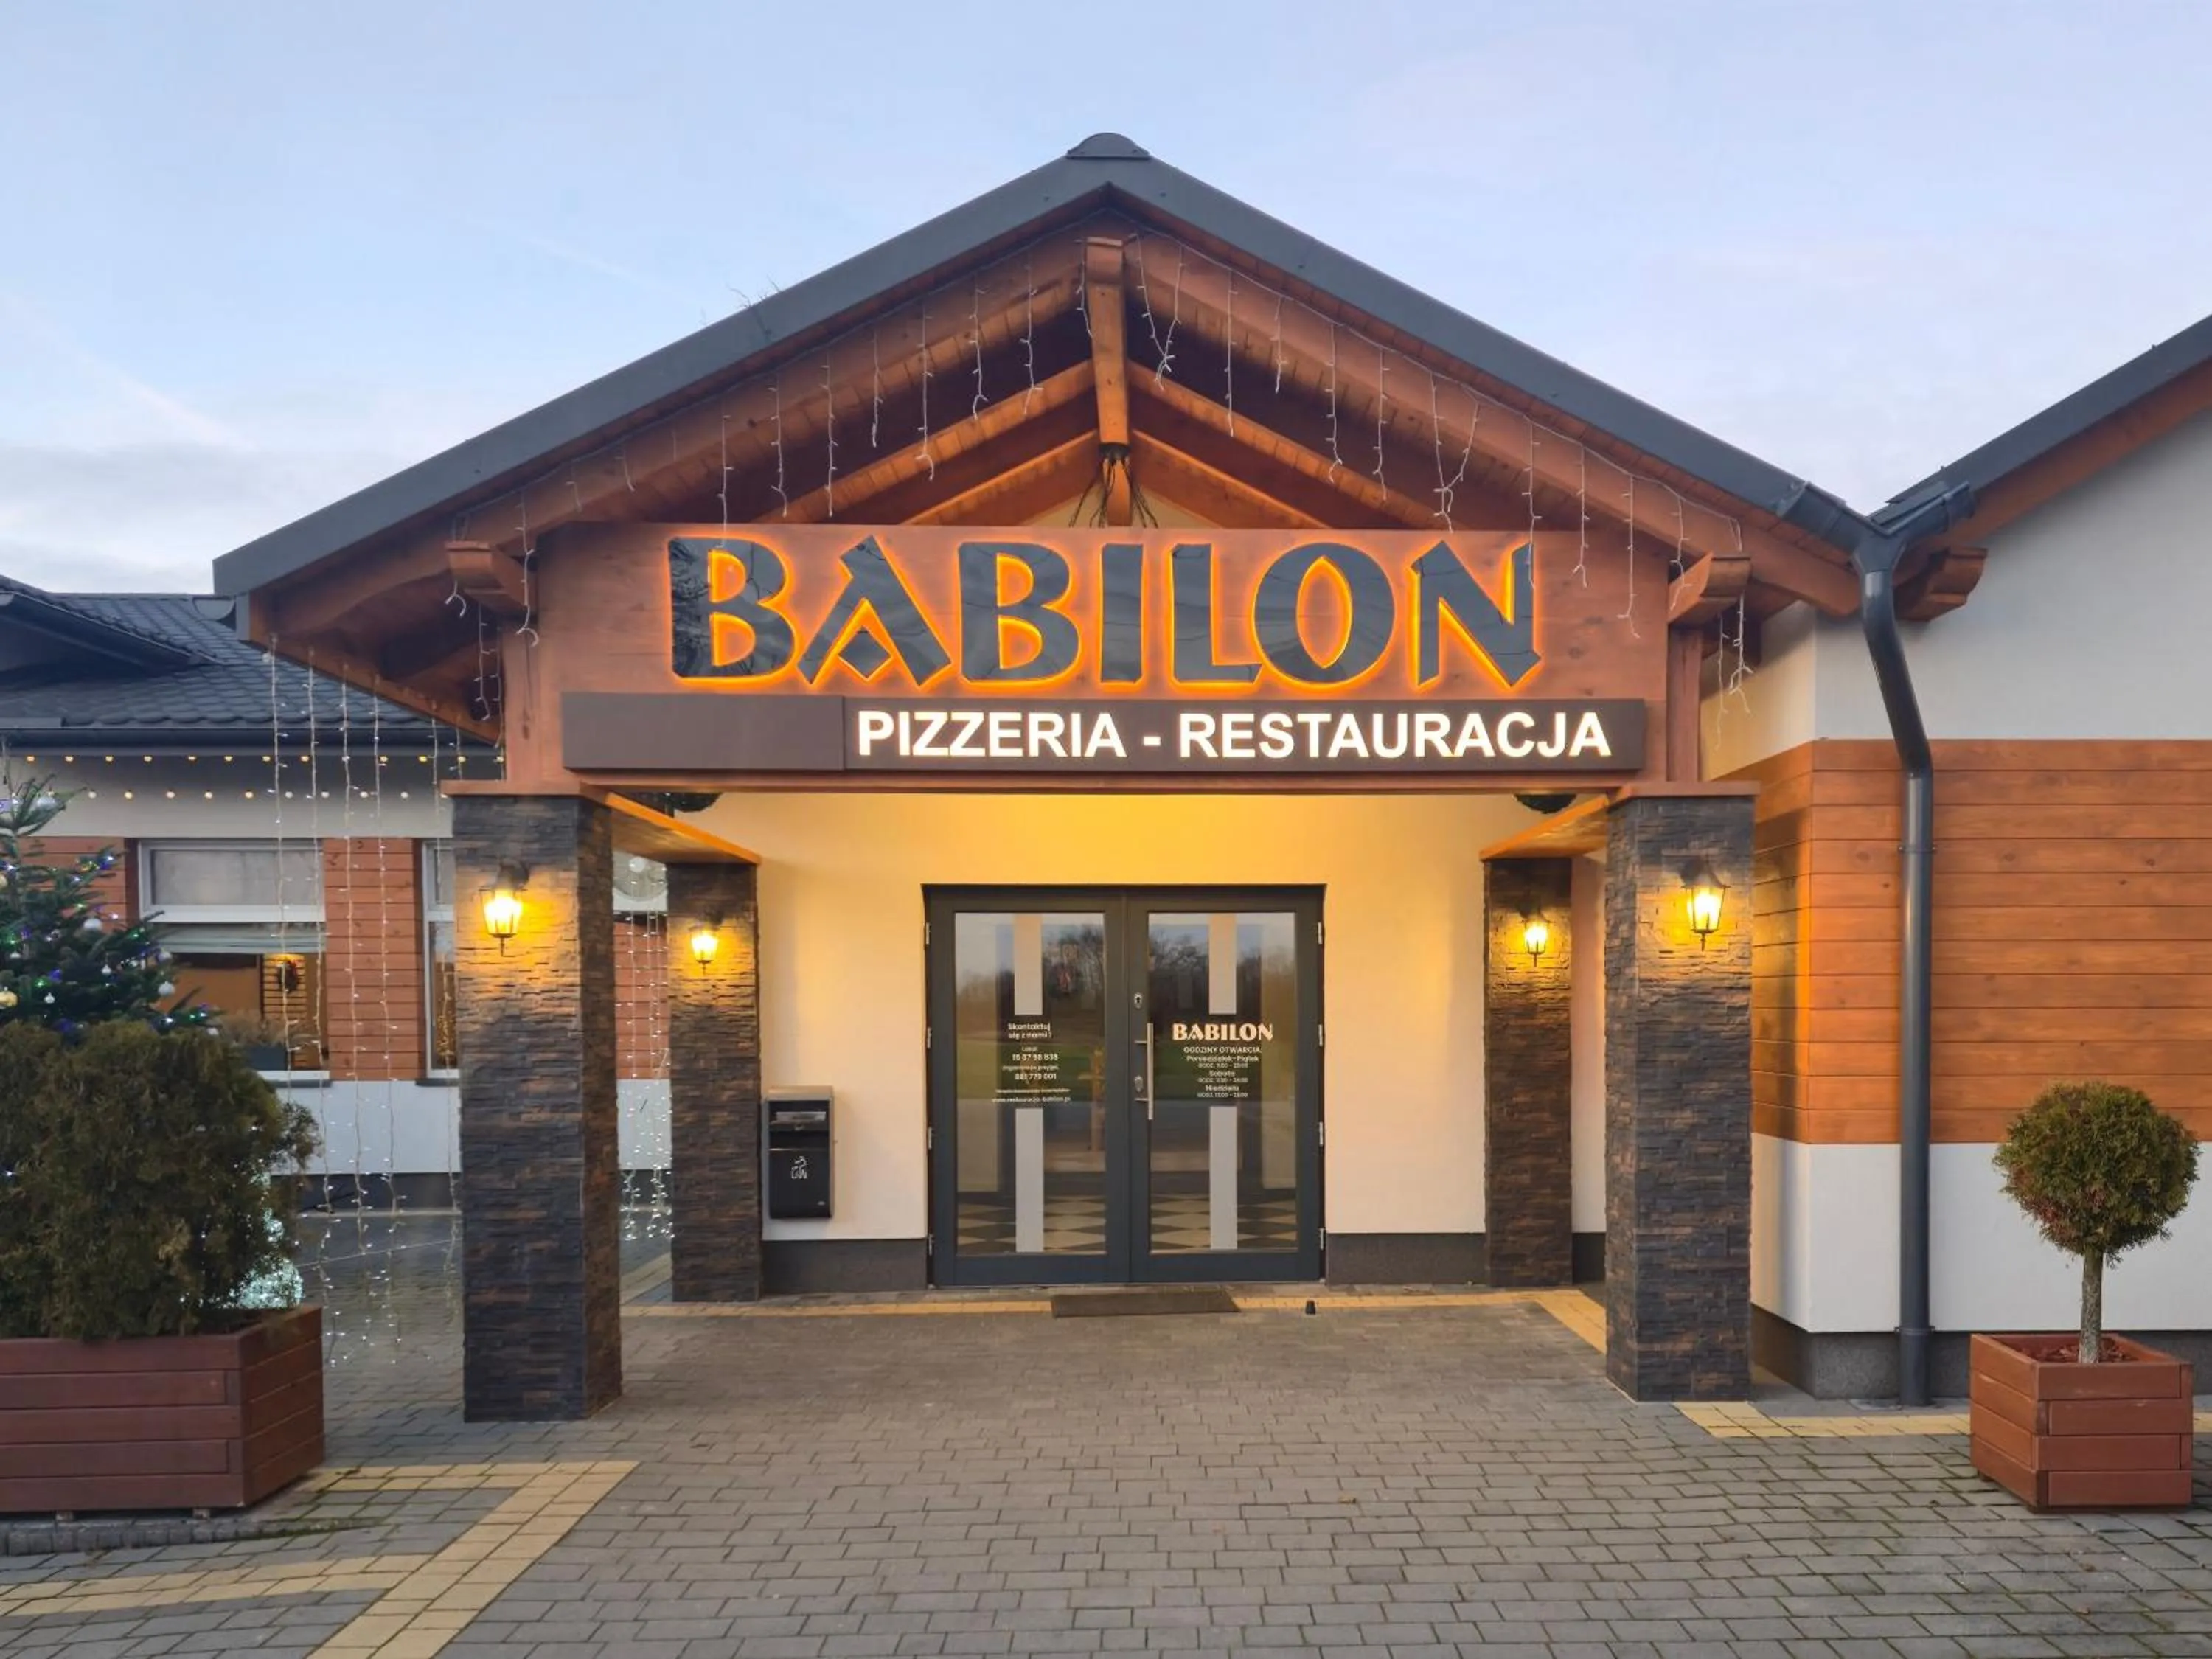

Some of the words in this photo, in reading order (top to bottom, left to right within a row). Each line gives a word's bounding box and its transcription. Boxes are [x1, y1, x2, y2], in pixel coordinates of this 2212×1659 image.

[668, 535, 1543, 687] BABILON
[858, 710, 1127, 758] PIZZERIA
[1143, 736, 1161, 747] -
[1179, 712, 1612, 759] RESTAURACJA
[1172, 1023, 1274, 1041] BABILON
